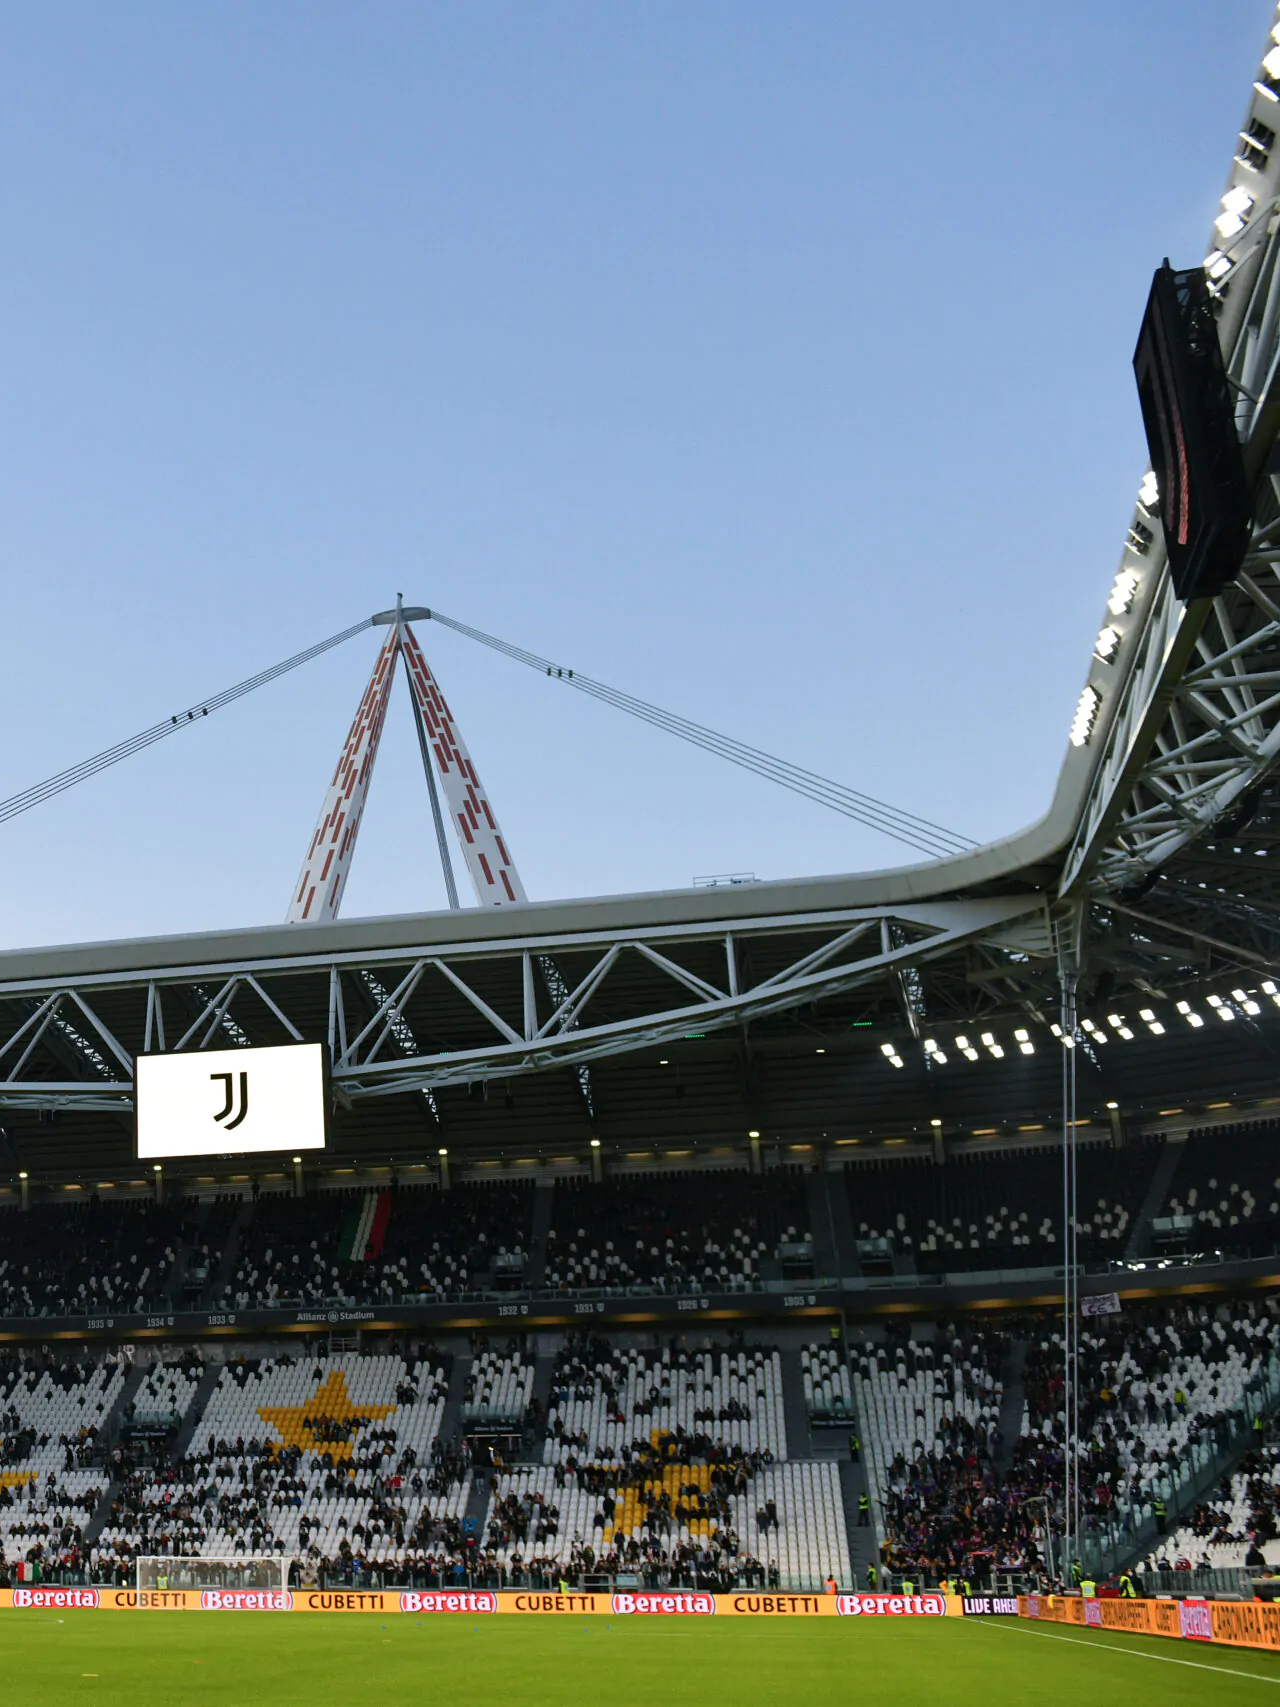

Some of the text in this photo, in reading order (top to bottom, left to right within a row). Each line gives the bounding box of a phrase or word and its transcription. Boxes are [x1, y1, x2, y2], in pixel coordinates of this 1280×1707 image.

[297, 1311, 374, 1321] Allianz Stadium
[498, 1306, 517, 1315] 1932
[88, 1320, 104, 1329] 1935
[147, 1317, 164, 1327] 1934
[208, 1315, 225, 1324] 1933
[15, 1589, 95, 1607] Beretta
[115, 1592, 186, 1607] CUBETTI
[207, 1590, 286, 1609] Beretta
[308, 1594, 384, 1609] CUBETTI
[405, 1592, 491, 1612] Beretta
[515, 1596, 595, 1611] CUBETTI
[617, 1593, 710, 1614] Beretta
[734, 1597, 819, 1613] CUBETTI
[843, 1594, 941, 1615] Beretta
[964, 1598, 991, 1614] LIVE
